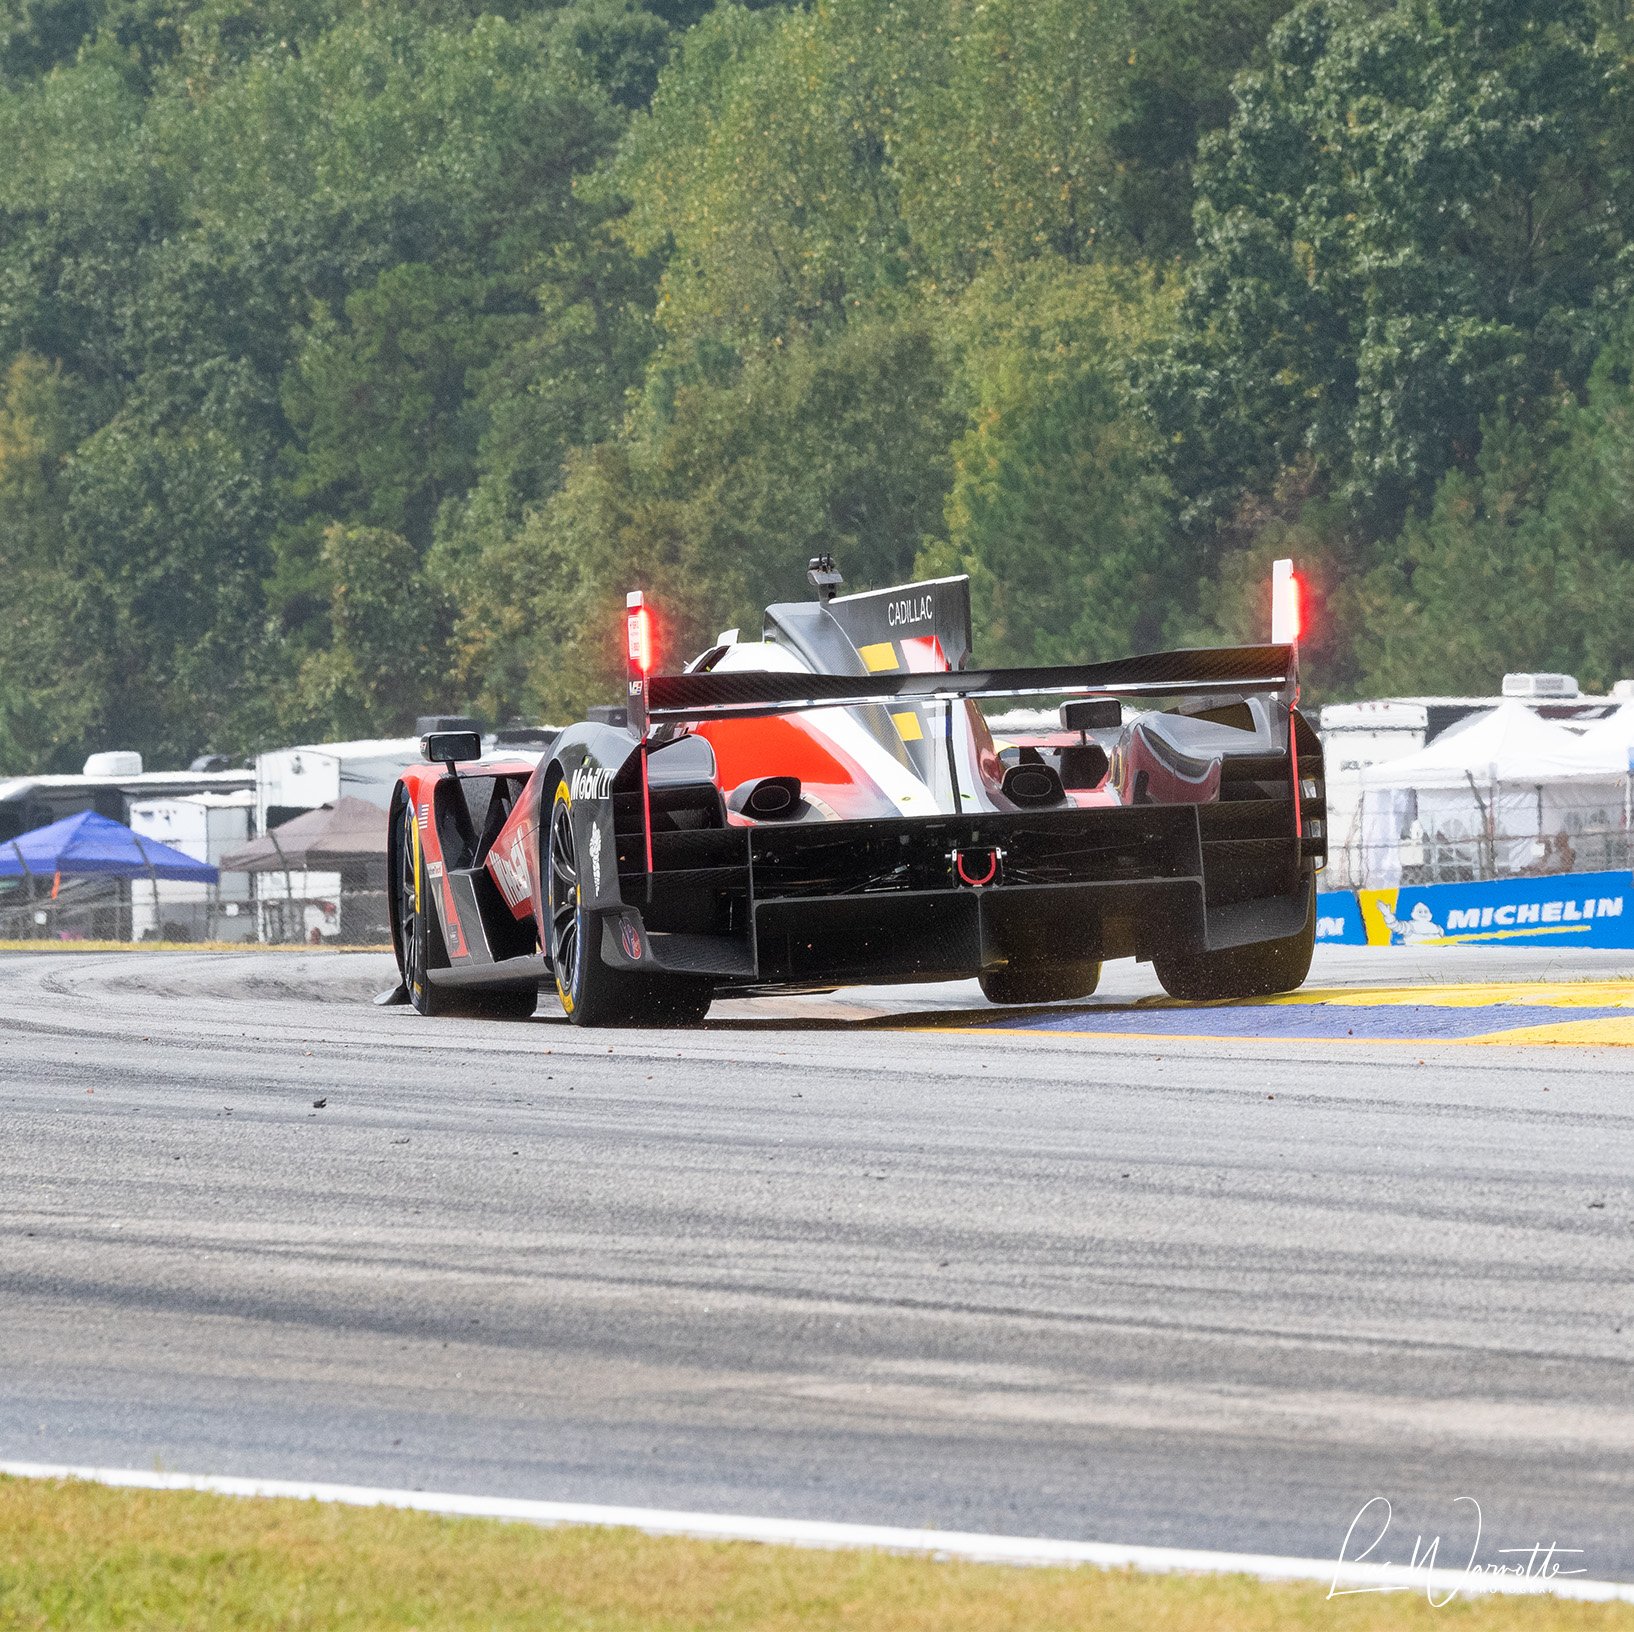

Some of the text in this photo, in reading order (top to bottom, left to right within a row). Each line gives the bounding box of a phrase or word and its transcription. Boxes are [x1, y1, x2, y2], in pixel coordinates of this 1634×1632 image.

[888, 594, 933, 627] CADILLAC
[571, 767, 603, 800] Mobil
[1447, 896, 1624, 930] MICHELIN
